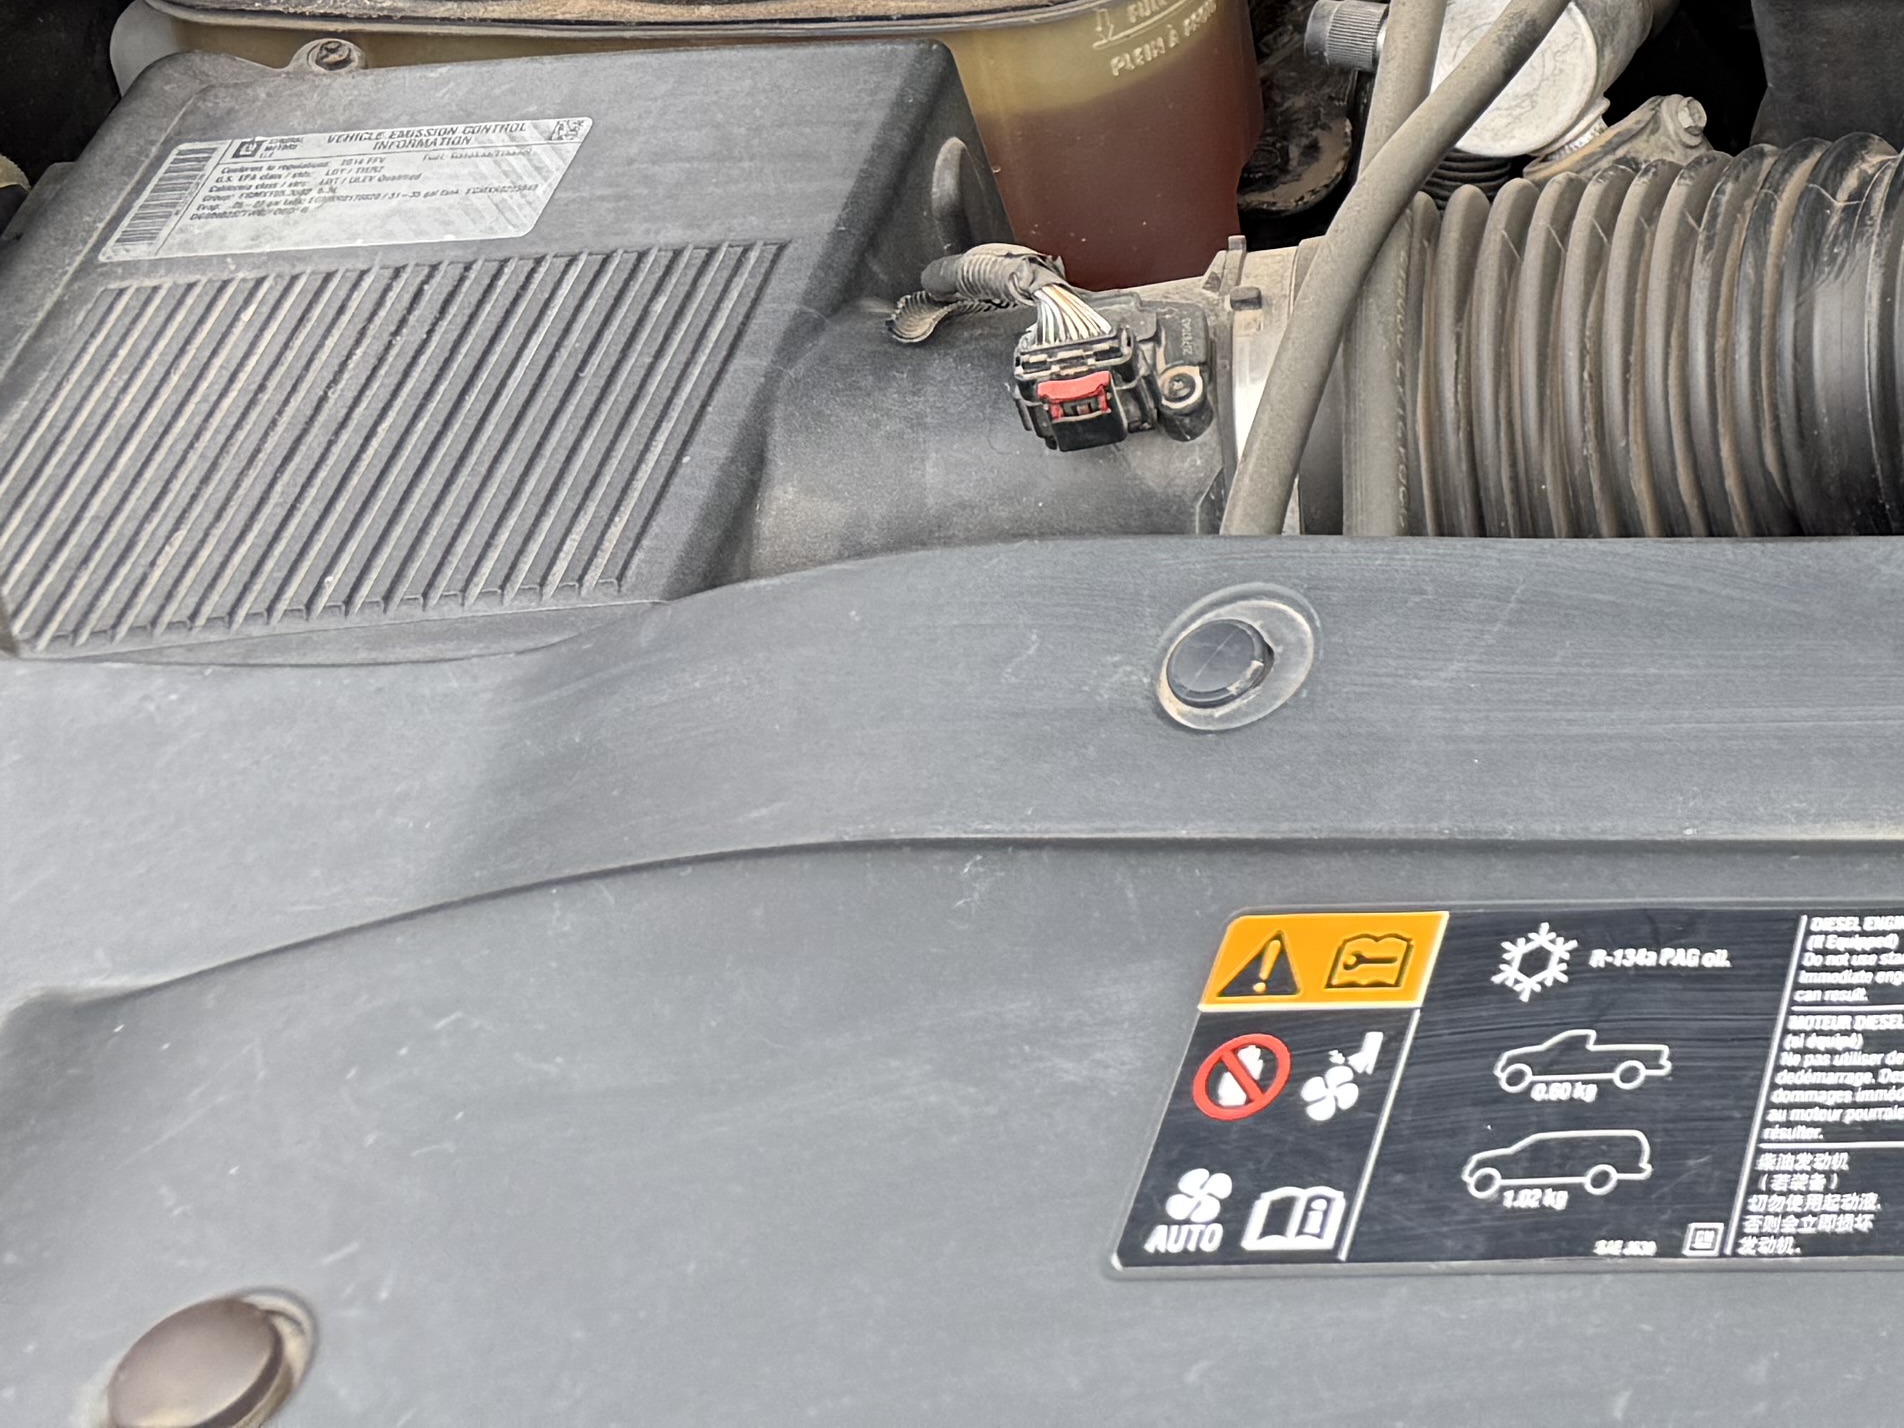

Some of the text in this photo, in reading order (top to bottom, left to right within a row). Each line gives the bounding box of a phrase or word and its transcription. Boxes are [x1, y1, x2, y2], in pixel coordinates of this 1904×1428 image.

[327, 123, 527, 144] VEHICLE EMISSION CONTROL
[373, 136, 472, 151] INFORMATION
[1810, 916, 1861, 931] DIESEL
[1658, 947, 1700, 968] PAG
[1802, 952, 1823, 966] Do
[1824, 953, 1849, 966] not
[1851, 953, 1877, 966] use
[1798, 969, 1873, 984] Immediate
[1794, 988, 1868, 1002] can result.
[1787, 1015, 1852, 1030] MOTEUR
[1779, 1052, 1801, 1066] Ne
[1802, 1054, 1831, 1068] pas
[1833, 1051, 1884, 1066] utiliser
[1885, 1050, 1904, 1066] de
[1572, 1081, 1598, 1102] kg
[1770, 1087, 1853, 1105] dommages
[1766, 1109, 1787, 1122] au
[1789, 1107, 1843, 1122] moteur
[1762, 1124, 1824, 1140] résulter.
[1543, 1188, 1569, 1210] kg
[1143, 1223, 1224, 1253] AUTO
